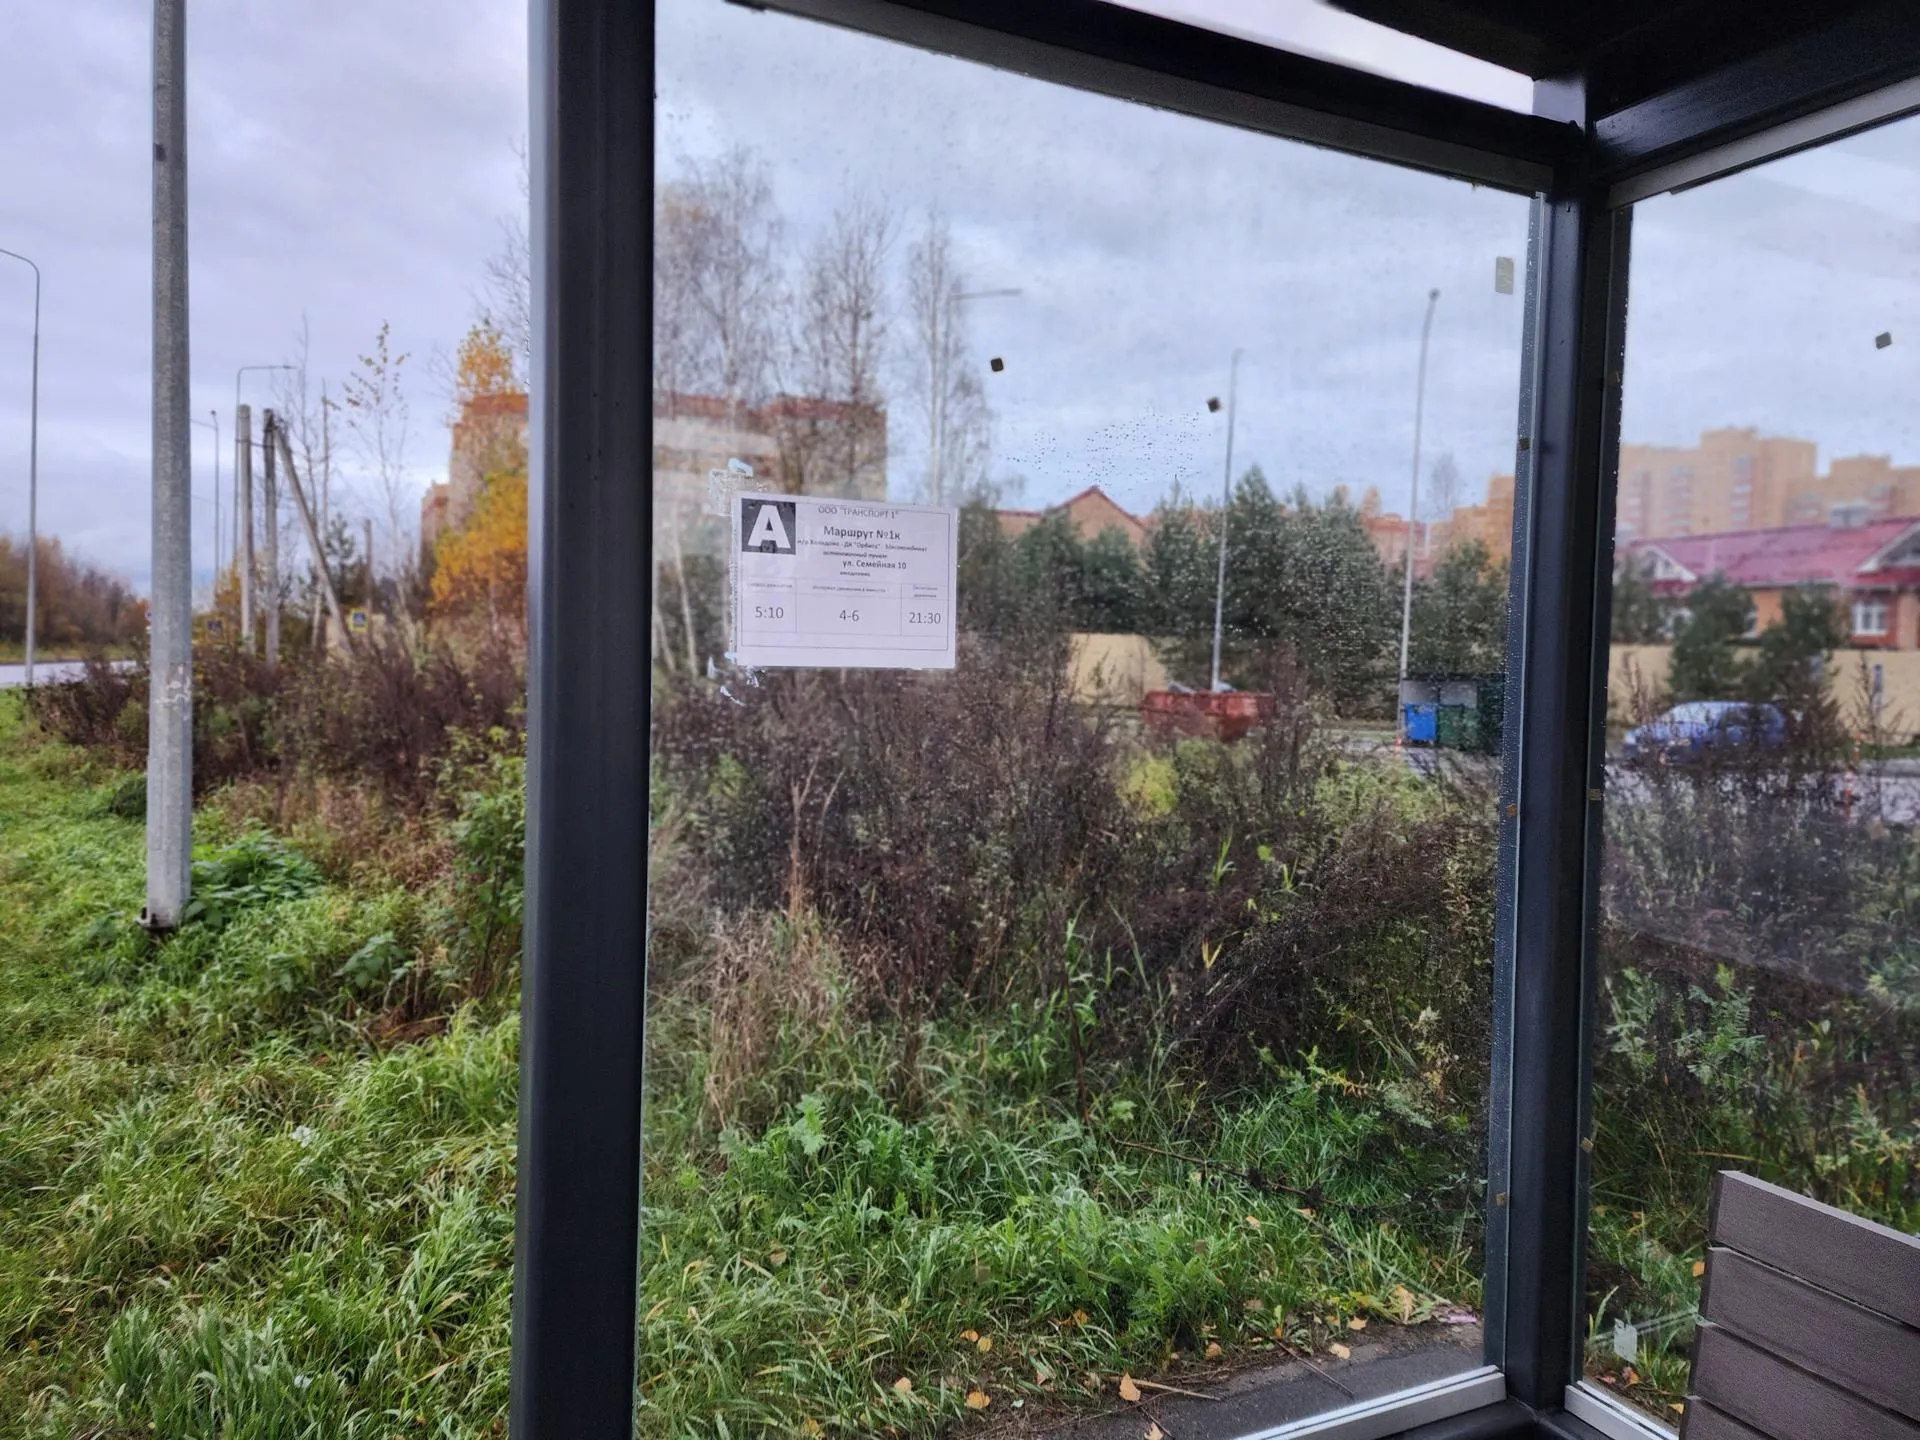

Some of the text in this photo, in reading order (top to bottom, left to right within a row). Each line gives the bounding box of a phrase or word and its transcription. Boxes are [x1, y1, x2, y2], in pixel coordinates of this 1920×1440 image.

[818, 507, 838, 515] ООО
[823, 525, 874, 540] Маршрут
[842, 559, 907, 570] ул. Семейная 10
[755, 606, 785, 619] 5:10
[839, 609, 860, 622] 4-6
[908, 612, 941, 625] 21:30
